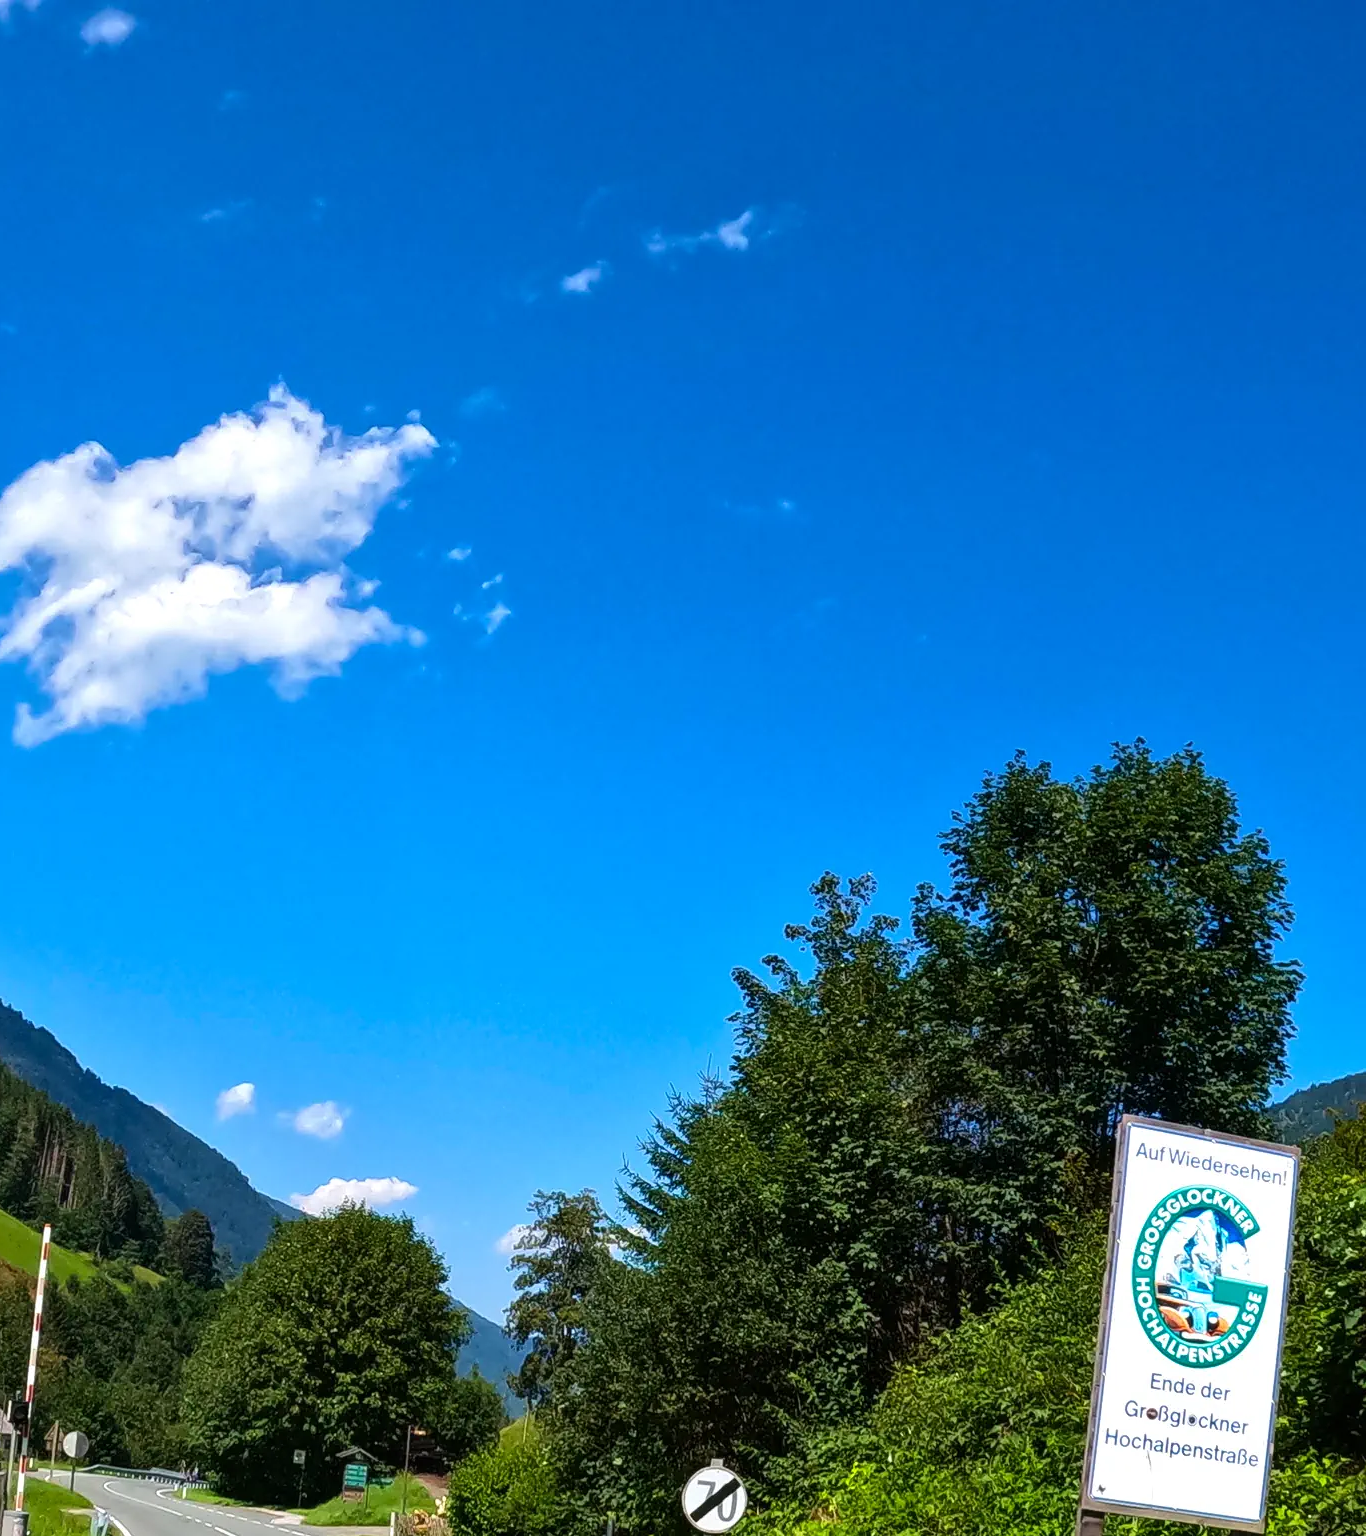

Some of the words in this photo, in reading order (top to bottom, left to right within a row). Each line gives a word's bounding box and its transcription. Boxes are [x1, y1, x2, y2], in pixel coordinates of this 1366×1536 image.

[1135, 1142, 1166, 1161] Auf
[1169, 1147, 1288, 1186] Wiedersehen!
[1136, 1188, 1255, 1270] GROSSGLOCKNER
[1135, 1277, 1263, 1363] HOCHALPENSTRASSE
[1150, 1372, 1196, 1396] Ende
[1200, 1381, 1231, 1401] der
[1104, 1427, 1259, 1467] Hochalpenstraße
[697, 1479, 738, 1522] 70
